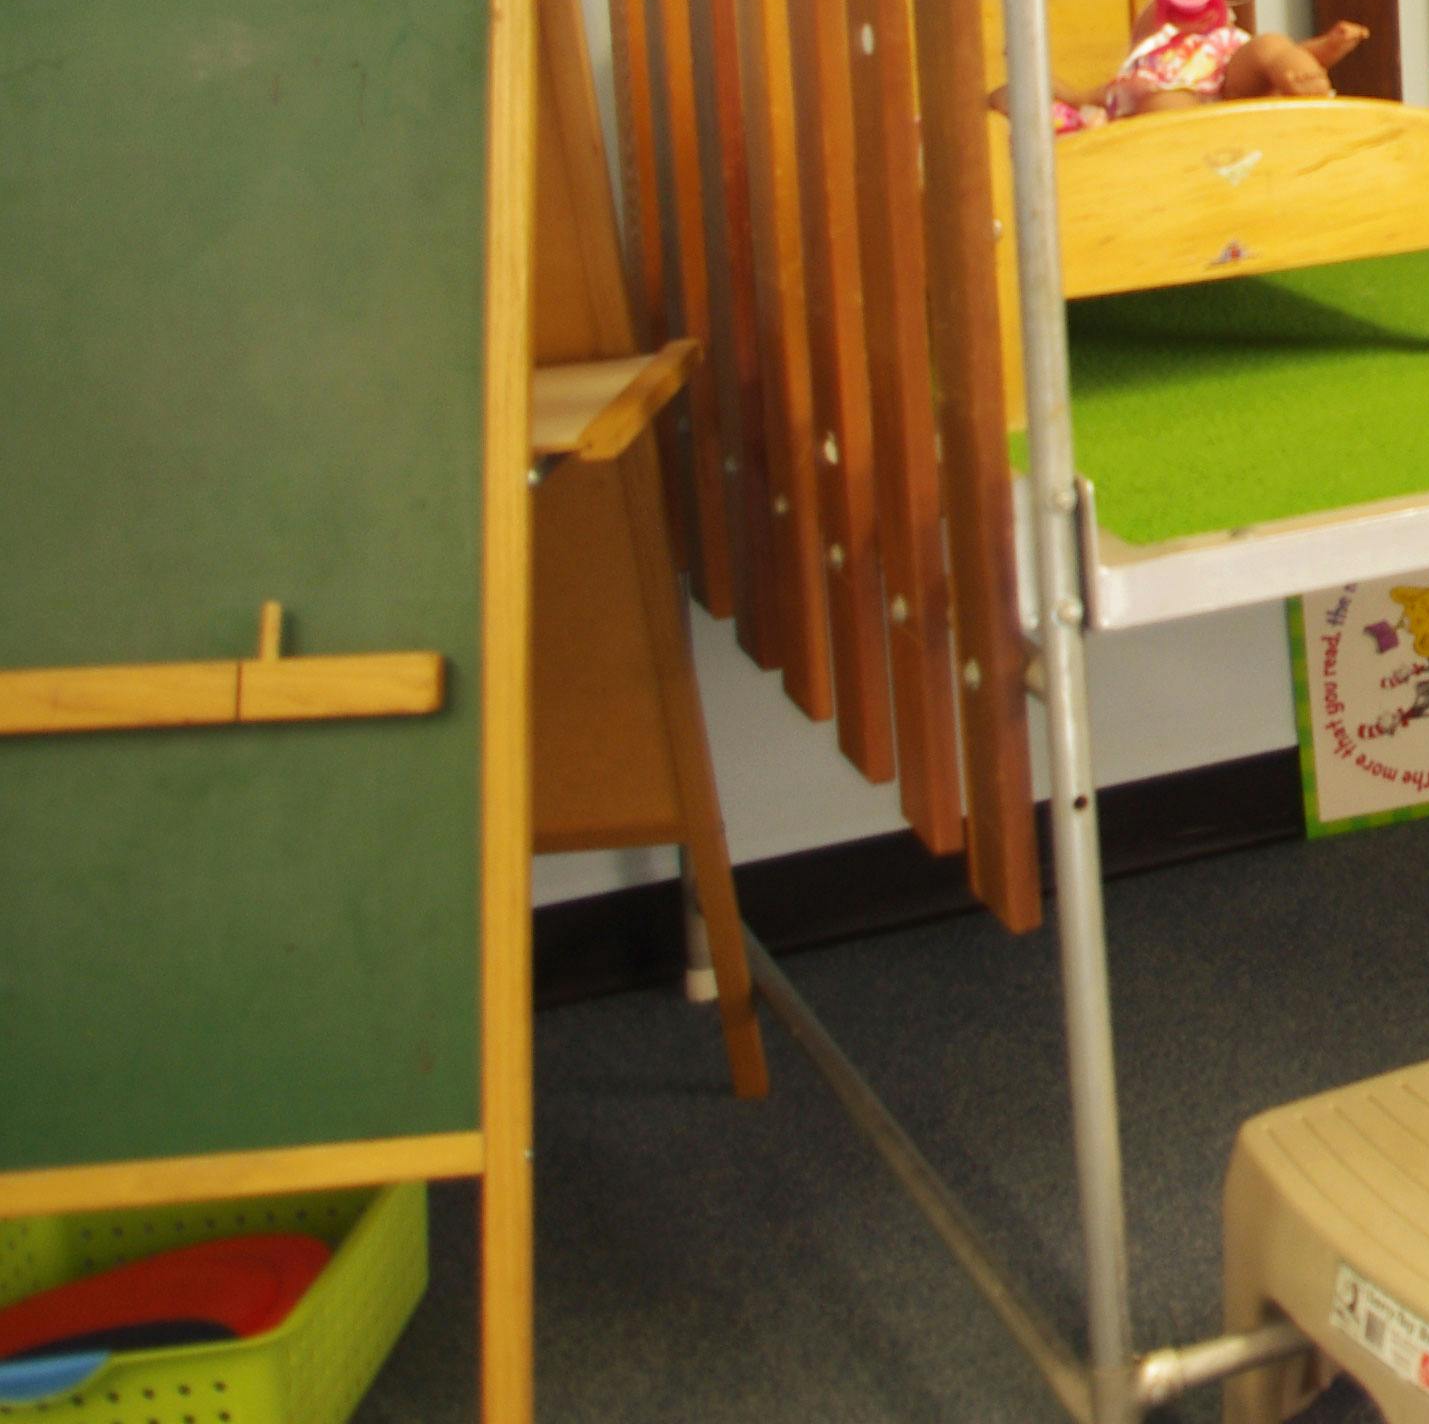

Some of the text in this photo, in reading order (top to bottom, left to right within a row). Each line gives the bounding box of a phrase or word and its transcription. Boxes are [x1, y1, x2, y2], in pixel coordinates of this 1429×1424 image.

[1323, 681, 1345, 716] you
[1324, 719, 1356, 759] that
[1355, 754, 1398, 782] more
